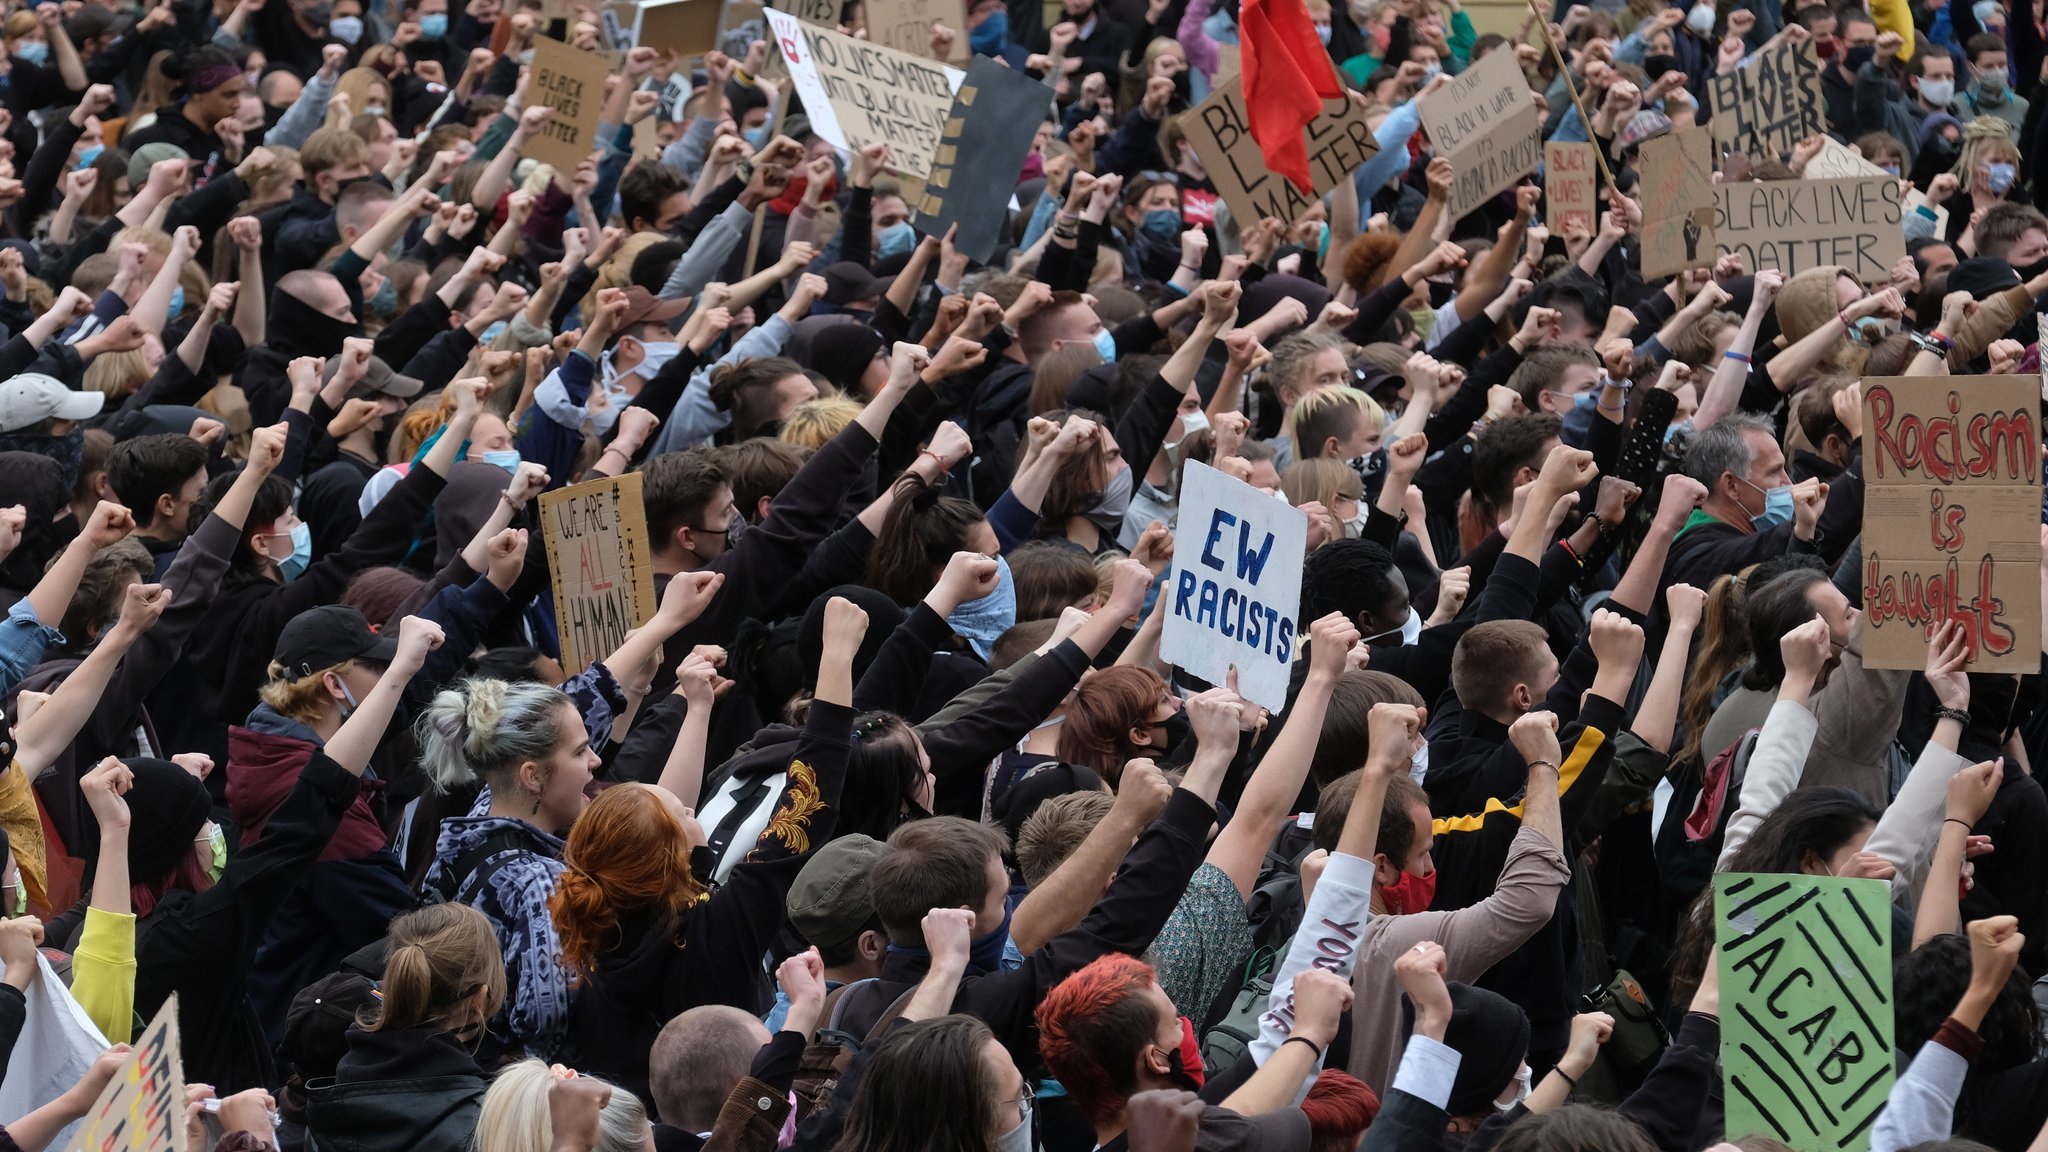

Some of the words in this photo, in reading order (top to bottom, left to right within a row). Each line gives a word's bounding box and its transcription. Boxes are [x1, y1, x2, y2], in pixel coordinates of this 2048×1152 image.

[537, 67, 585, 99] BLACK
[801, 26, 837, 68] NO
[838, 42, 896, 87] LIVES
[889, 57, 951, 99] MATTER
[1714, 38, 1818, 114] BLACK
[542, 91, 580, 118] LIVES
[866, 111, 938, 152] MATTER
[1436, 108, 1477, 152] BLACK
[1735, 72, 1816, 137] LIVES
[1253, 120, 1380, 226] MATER
[1553, 150, 1588, 172] BLACK
[1554, 179, 1584, 204] LIVES
[1713, 184, 1807, 231] BLACK
[1813, 180, 1901, 225] LIVES
[1864, 384, 2036, 485] Racism
[557, 498, 582, 539] WE
[584, 492, 608, 534] ARE
[1201, 508, 1275, 586] EW
[1930, 487, 1966, 553] is
[580, 533, 613, 594] ALL
[571, 587, 626, 673] HUMAN
[1174, 568, 1294, 664] RACISTS
[1864, 550, 2016, 664] taught
[1732, 937, 1865, 1085] ACAB
[127, 1021, 174, 1152] DEUT
